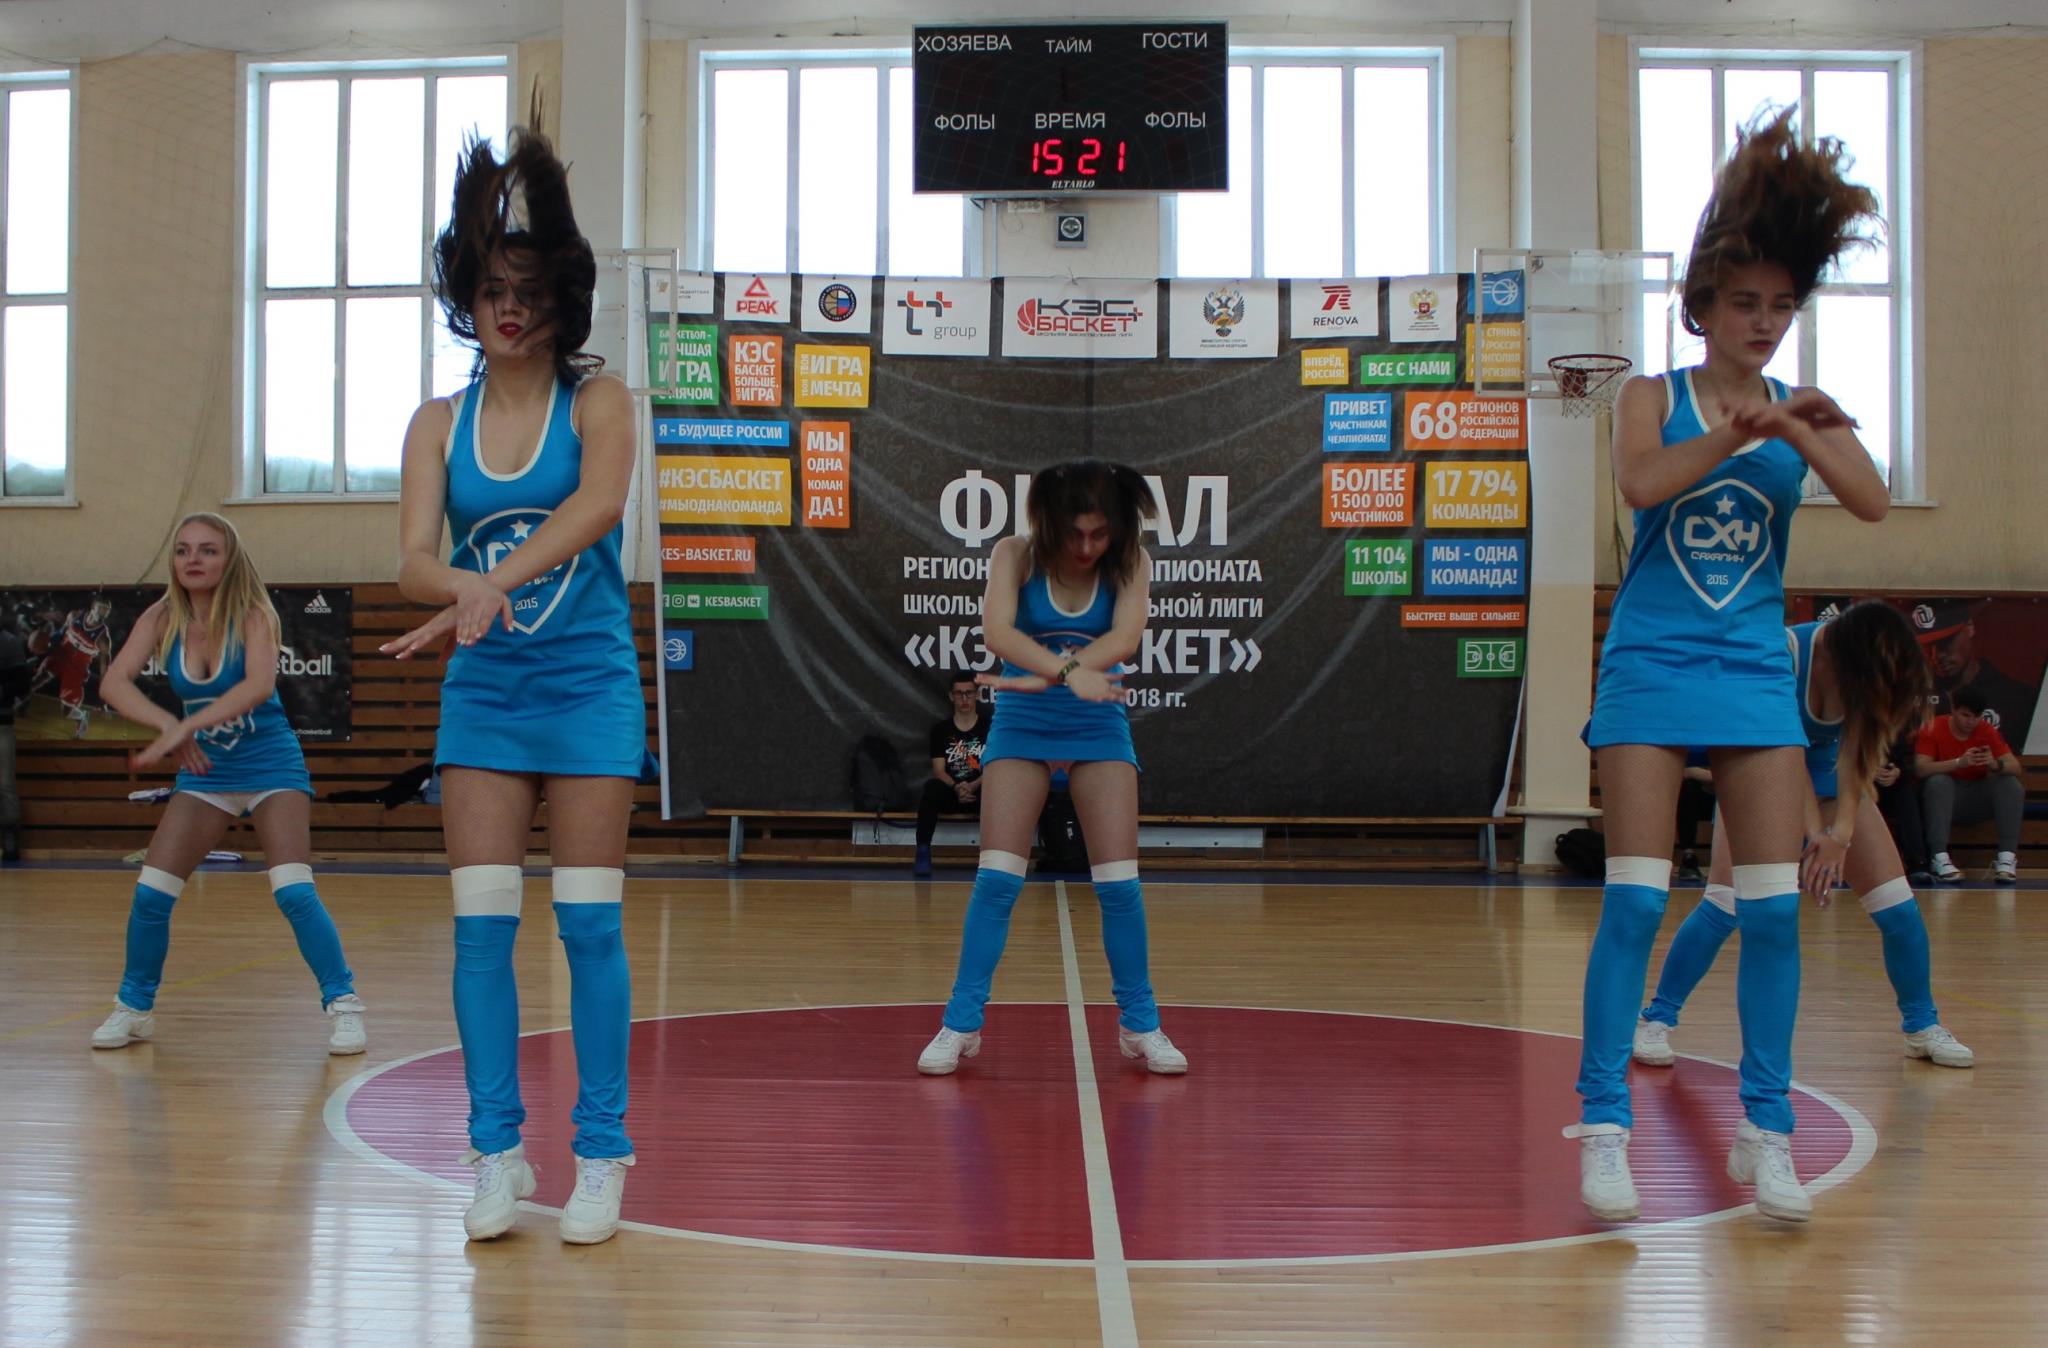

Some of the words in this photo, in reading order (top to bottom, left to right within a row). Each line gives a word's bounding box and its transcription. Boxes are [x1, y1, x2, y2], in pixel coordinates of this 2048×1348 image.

[918, 34, 1012, 52] ХОЗЯЕВА
[1045, 36, 1092, 53] ТАЙМ
[1143, 32, 1208, 49] ГОСТИ
[935, 114, 995, 130] ФОЛЫ
[1035, 113, 1106, 129] ВРЕМЯ
[1145, 112, 1206, 128] ФОЛЫ
[736, 300, 779, 315] PEAK
[1037, 316, 1132, 332] БАСКЕТ
[1313, 316, 1359, 327] RENOVA
[659, 329, 706, 339] БАКЕТБОЛ
[934, 325, 977, 340] group
[659, 342, 712, 357] ЛЧШАЯ
[735, 341, 775, 363] КЭС
[735, 364, 776, 376] БАСКЕТ
[811, 355, 863, 376] ИГРА
[1368, 362, 1393, 377] ВСЕ
[1397, 362, 1405, 377] С
[1409, 361, 1450, 376] НАМИ
[1305, 369, 1345, 379] РОССИЯ!
[735, 376, 779, 388] БОЛЬШЕ,
[810, 380, 863, 397] МЕЧТА
[742, 387, 775, 401] ИГРА
[1329, 400, 1387, 416] ПРИВЕТ
[1460, 402, 1519, 413] РЕГИОНОВ
[1329, 420, 1387, 430] УЧАСТНИКАМ
[1410, 401, 1457, 440] 68
[1460, 414, 1519, 425] РОССИЙСКОЙ
[659, 424, 668, 436] Я
[678, 425, 733, 439] БУДУЩЕЕ
[736, 426, 782, 439] РОССИИ
[1328, 434, 1386, 444] ЧЕМПИОНАТА!
[1460, 428, 1519, 440] ФЕДЕРАЦИИ
[807, 431, 844, 452] МЫ
[807, 457, 843, 473] ОДНА
[659, 468, 784, 490] #КЭСБАСКЕТ
[808, 480, 843, 490] КОМАН
[1331, 468, 1407, 492] БОЛЕЕ
[1432, 470, 1462, 497] 17
[1468, 469, 1518, 497] 794
[659, 500, 783, 515] #МЫОДНАКОМАНДА
[1331, 494, 1338, 508] 1
[1342, 494, 1371, 508] 500
[1375, 493, 1404, 508] 000
[1331, 511, 1404, 523] УЧАСТНИКОВ
[1432, 503, 1519, 522] КОМАНДЫ
[1352, 547, 1369, 564] 11
[1374, 546, 1406, 564] 104
[1432, 546, 1460, 561] МЫ
[1475, 546, 1518, 564] ОДНА
[1352, 571, 1407, 585] ШКОЛЫ
[1431, 569, 1518, 588] КОМАНДА!
[1706, 574, 1729, 585] 2015
[514, 597, 539, 611] 2015
[704, 596, 762, 607] KESBASKET
[1208, 598, 1263, 618] ЛИГИ
[304, 606, 332, 614] adidas
[1405, 612, 1446, 621] БЫСТРЕЕ!
[1449, 612, 1478, 621] ВЫШЕ!
[1481, 612, 1520, 621] СИЛЬНЕЕ!
